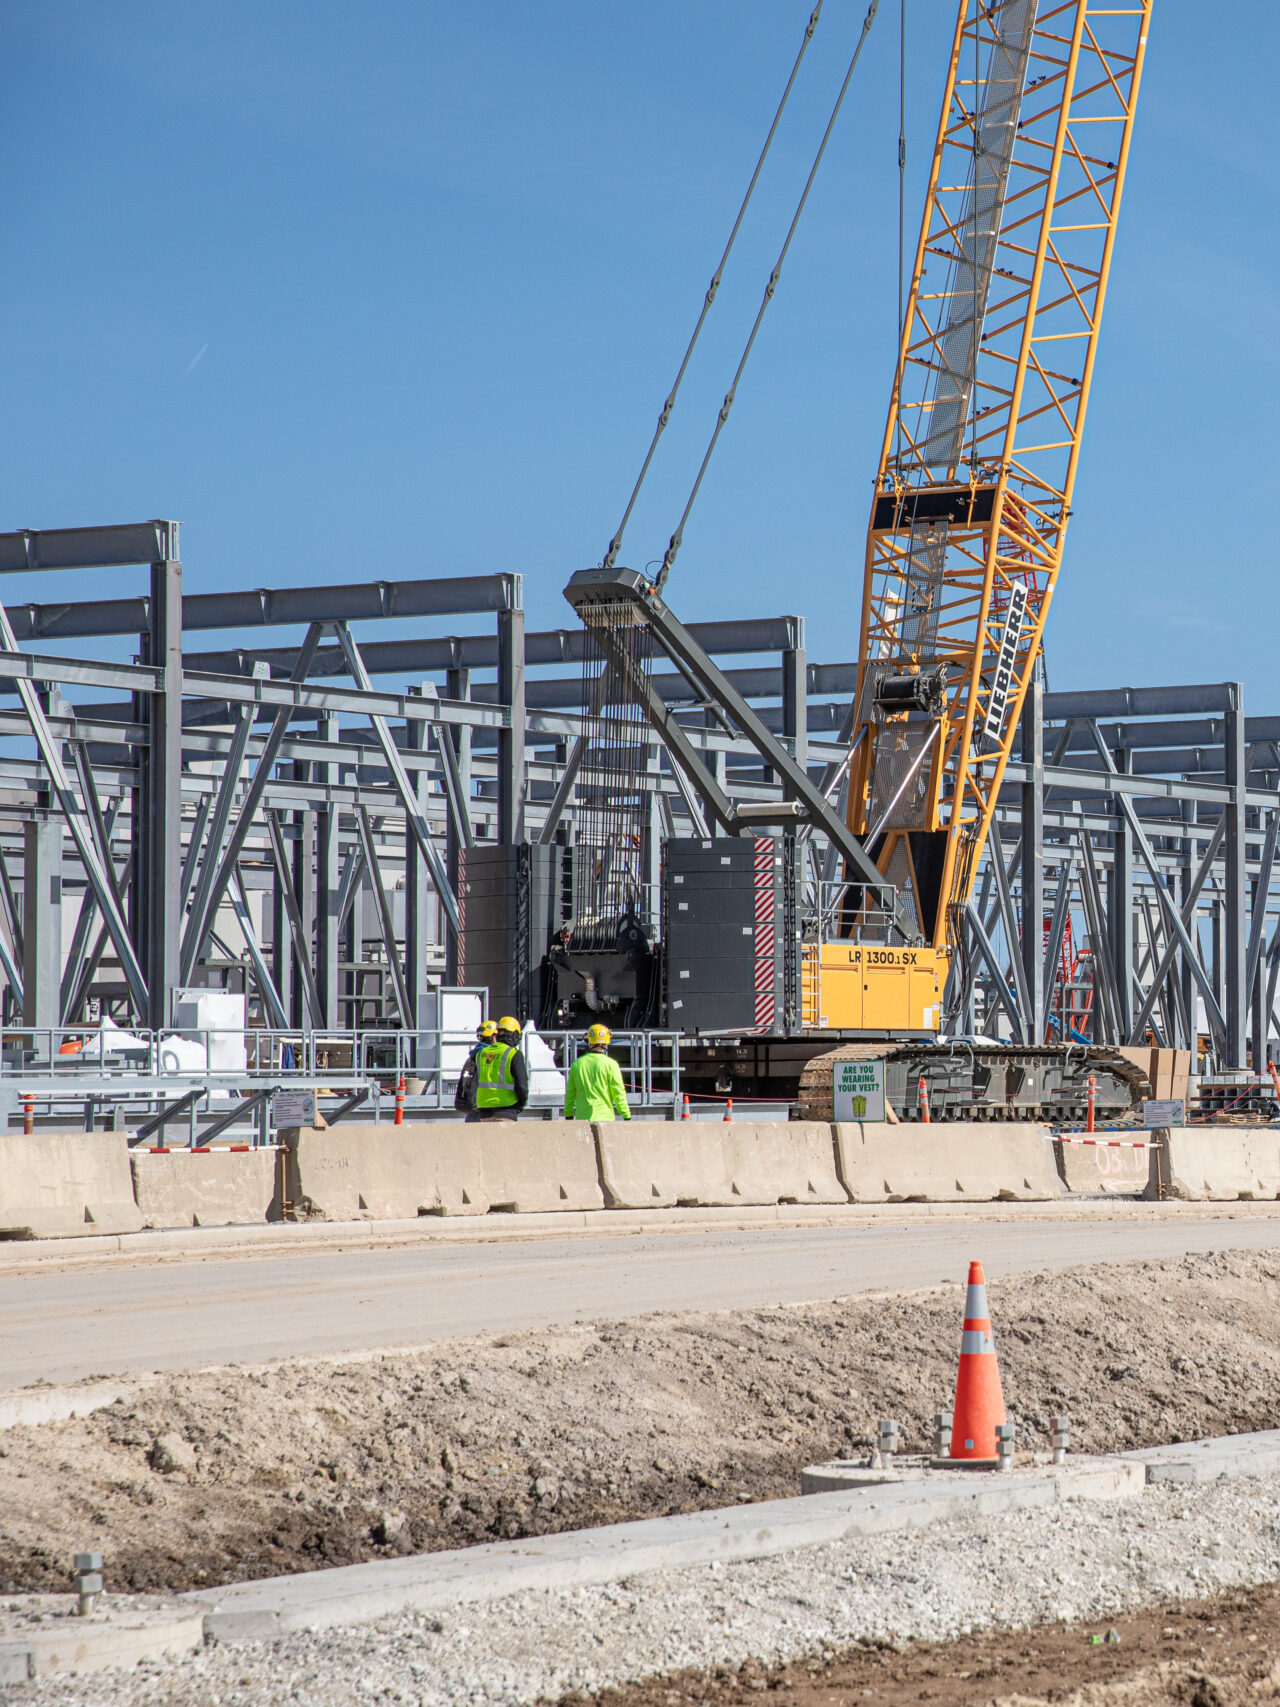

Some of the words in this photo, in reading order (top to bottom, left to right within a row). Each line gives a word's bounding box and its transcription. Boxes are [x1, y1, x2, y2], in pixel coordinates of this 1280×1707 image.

[987, 588, 1027, 735] LIEBHERR
[848, 950, 862, 963] LR
[843, 1066, 857, 1074] ARE
[859, 1065, 874, 1074] YOU
[842, 1074, 875, 1083] WEARING
[838, 1084, 857, 1092] YOUR
[859, 1083, 880, 1091] VEST?
